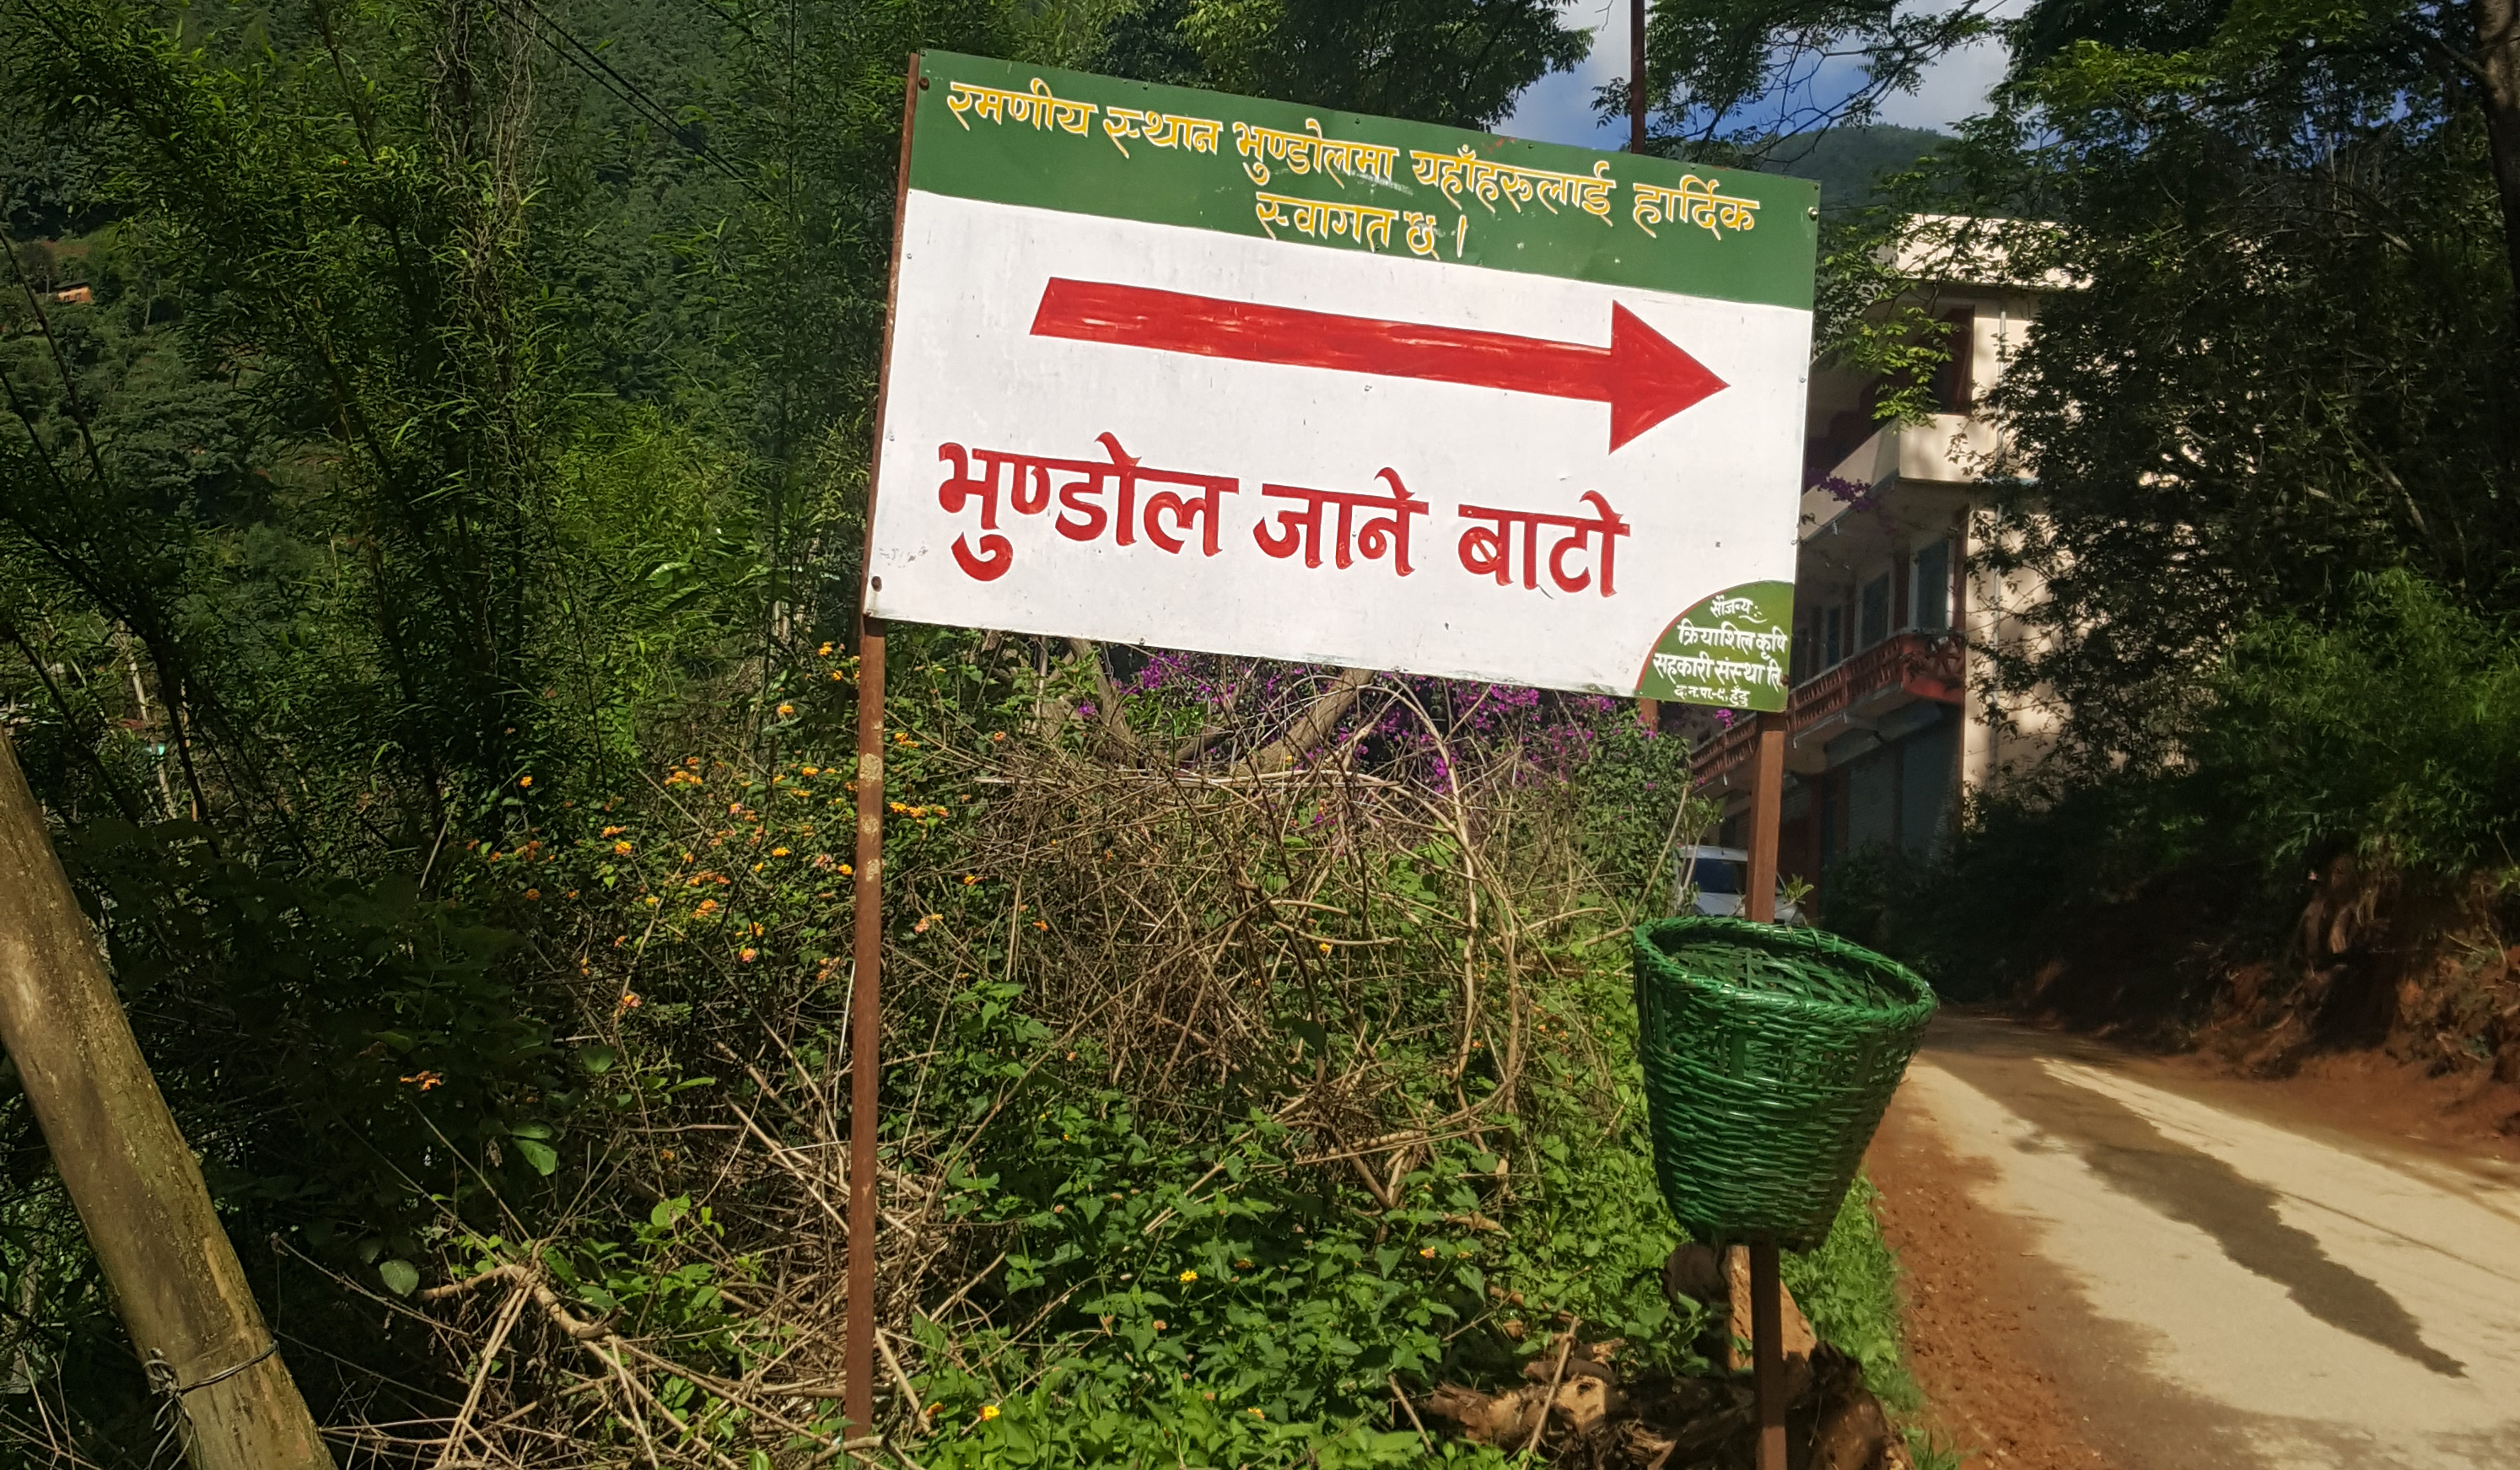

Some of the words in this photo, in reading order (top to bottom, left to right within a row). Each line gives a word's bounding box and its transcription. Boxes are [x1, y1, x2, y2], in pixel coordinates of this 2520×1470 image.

[946, 78, 1098, 137] रमणीय
[1102, 105, 1223, 159] स्थान
[1232, 118, 1400, 189] भुण्डोलमा
[1632, 175, 1760, 239] हार्दिक
[1256, 190, 1399, 252] स्वागत
[938, 431, 1239, 582] भुण्डोल
[1253, 467, 1429, 577] जाने
[1457, 489, 1630, 598] बाटो
[1653, 651, 1715, 684] सहकारी
[1715, 657, 1765, 685] संस्था
